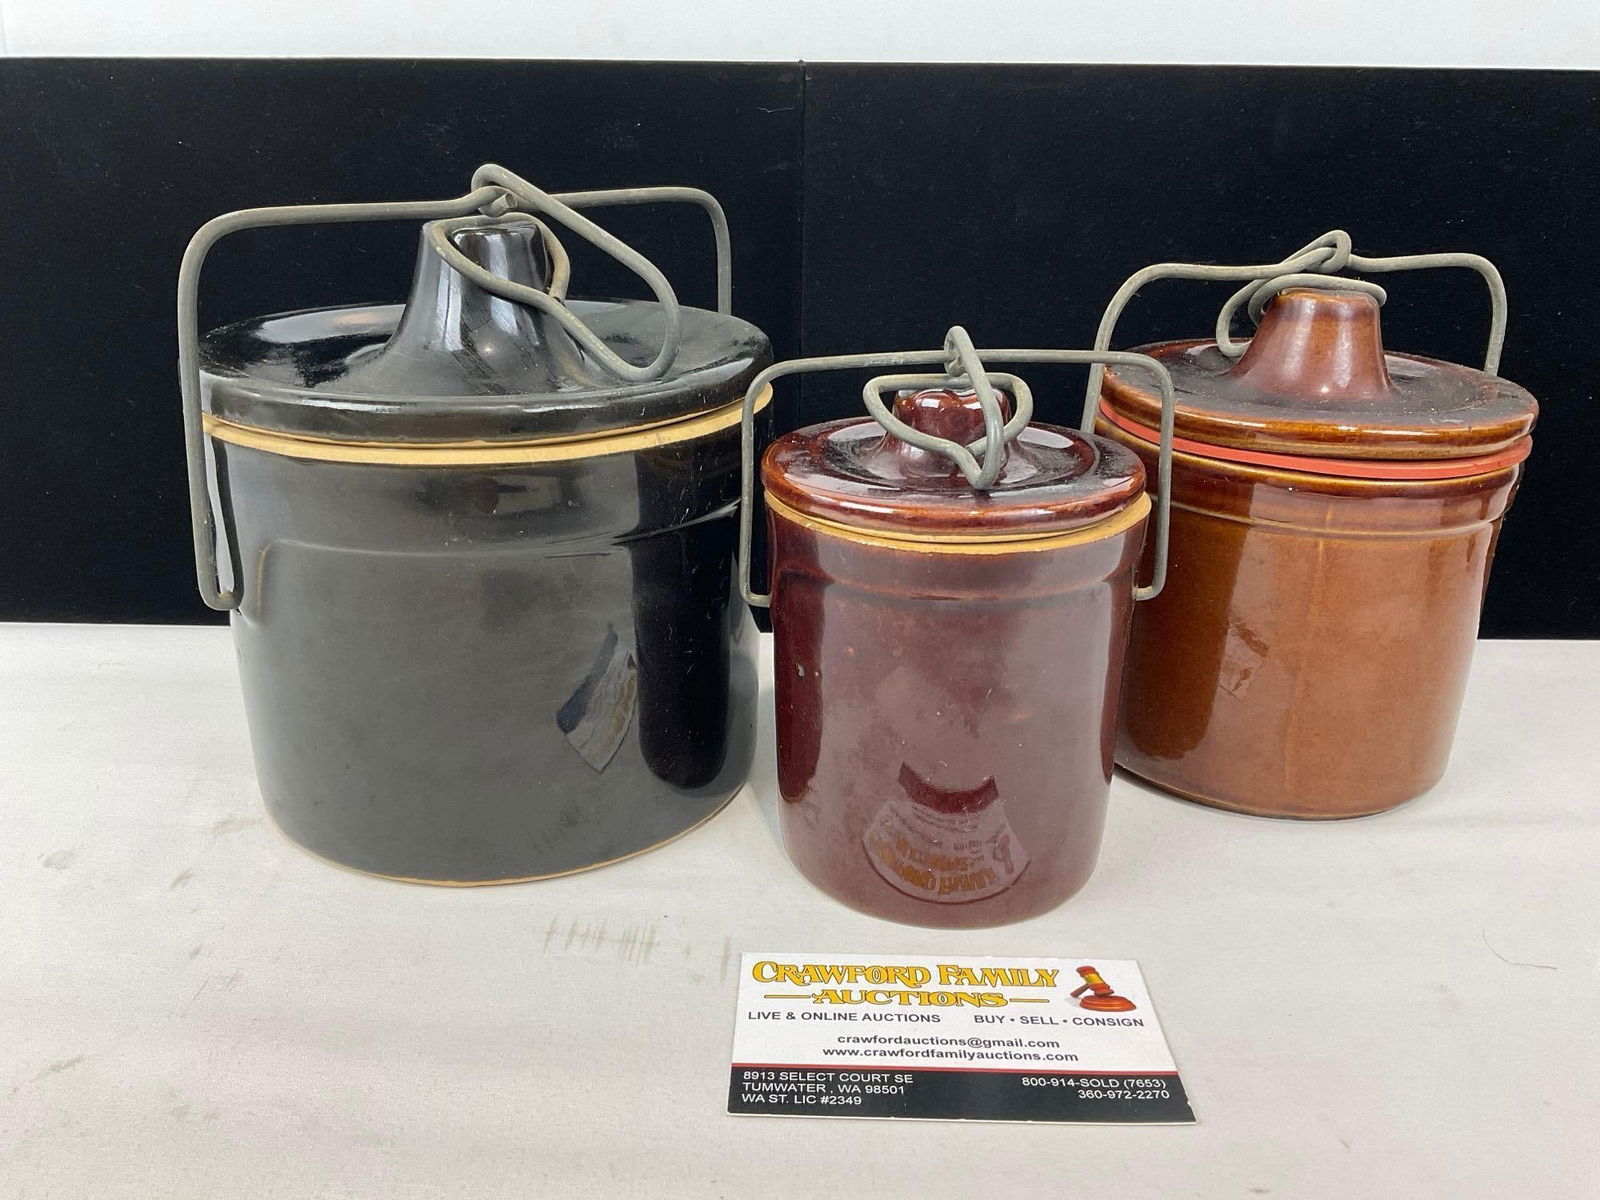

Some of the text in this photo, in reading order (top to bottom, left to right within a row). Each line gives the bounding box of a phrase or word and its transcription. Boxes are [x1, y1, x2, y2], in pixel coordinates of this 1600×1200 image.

[752, 960, 1060, 989] CRAWFORD FAMILY
[811, 989, 1009, 1009] AUCTIONS
[748, 1011, 942, 1024] LIVE & ONLINE AUCTIONS
[974, 1014, 1145, 1027] BUY SELL CONSIGN
[837, 1034, 1060, 1049] crawfordauctions@gmail.com
[822, 1048, 1079, 1062] www.crawfordfamilyauctions.com
[743, 1071, 914, 1084] 8913 SELECT COURT SE
[1022, 1077, 1167, 1090] 800-914-SOLD (7653)
[742, 1082, 827, 1093] TUMWATER
[837, 1084, 862, 1094] WA
[865, 1085, 905, 1095] 98501
[1077, 1089, 1170, 1100] 360-972-2270
[741, 1093, 862, 1106] WA ST. LIC #2349
